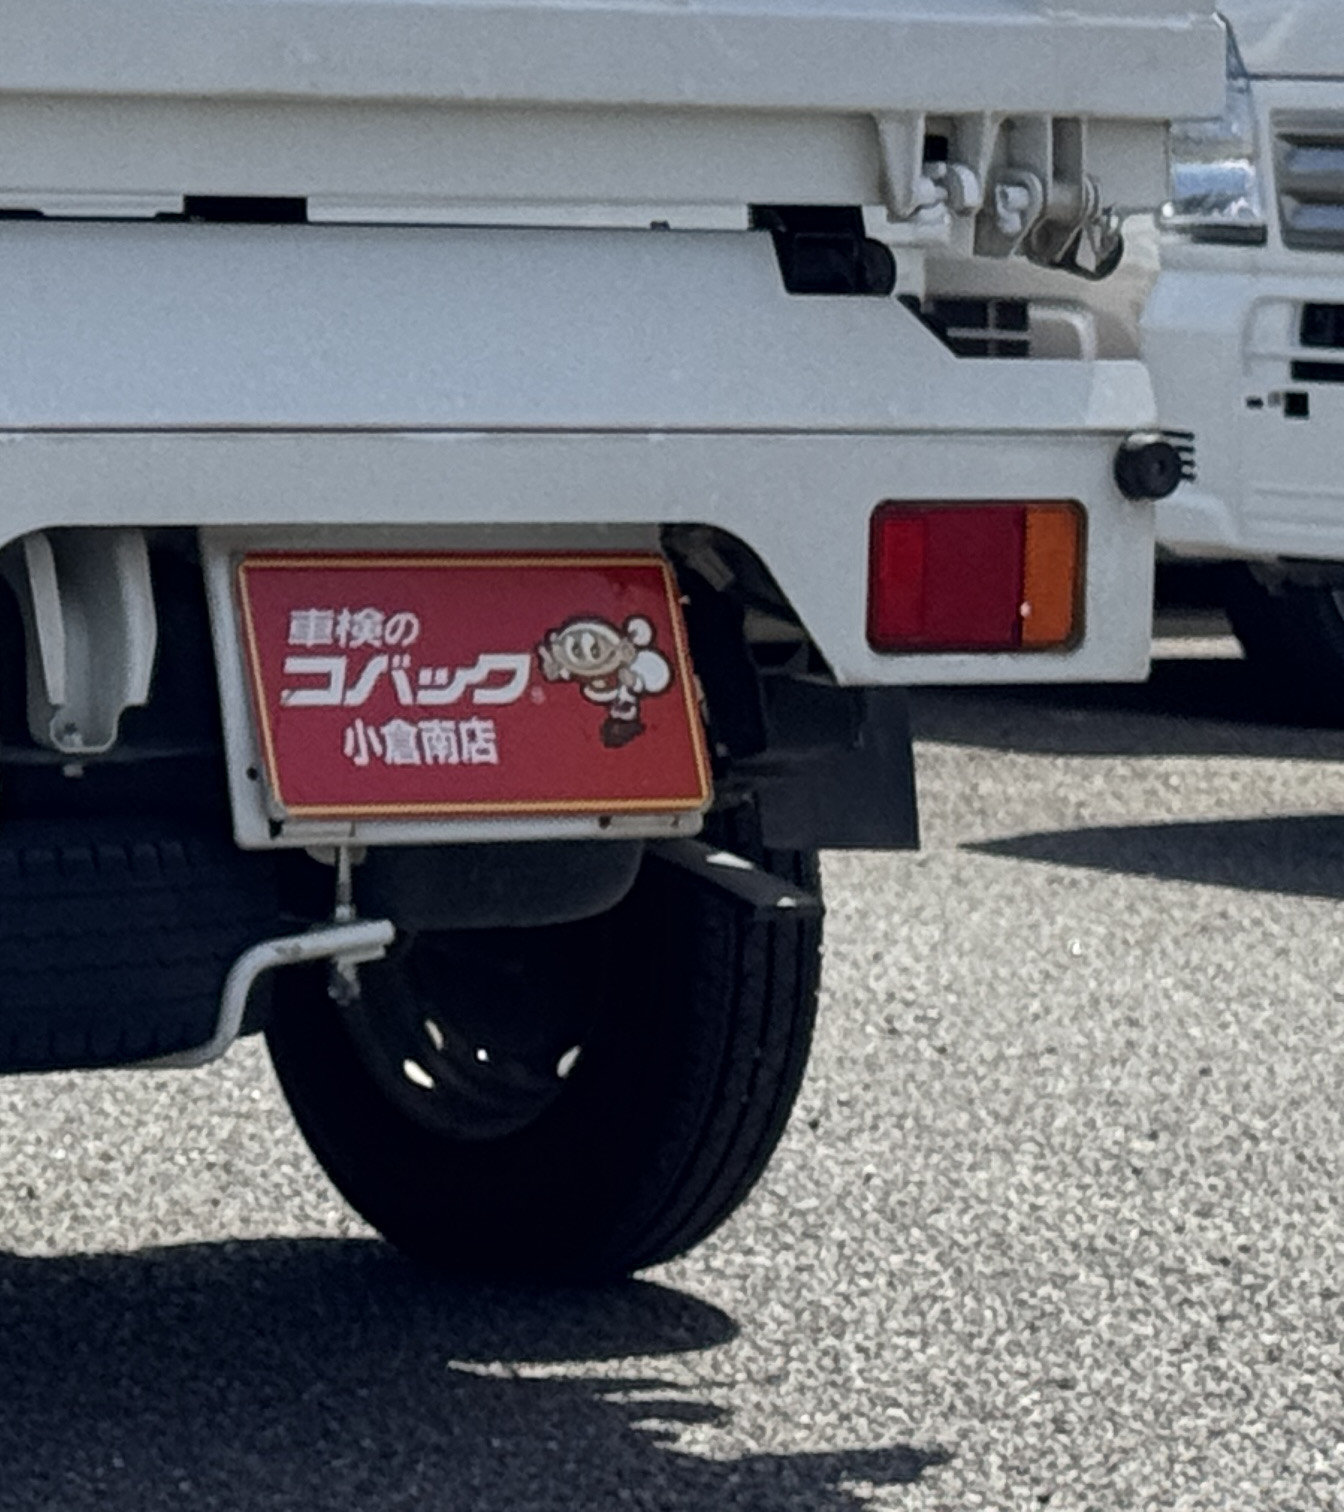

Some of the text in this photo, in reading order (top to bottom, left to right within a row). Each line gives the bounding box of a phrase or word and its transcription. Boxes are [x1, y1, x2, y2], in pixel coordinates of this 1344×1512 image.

[287, 607, 419, 649] 車検の
[280, 653, 531, 706] コバック
[343, 716, 498, 766] 小倉南店
